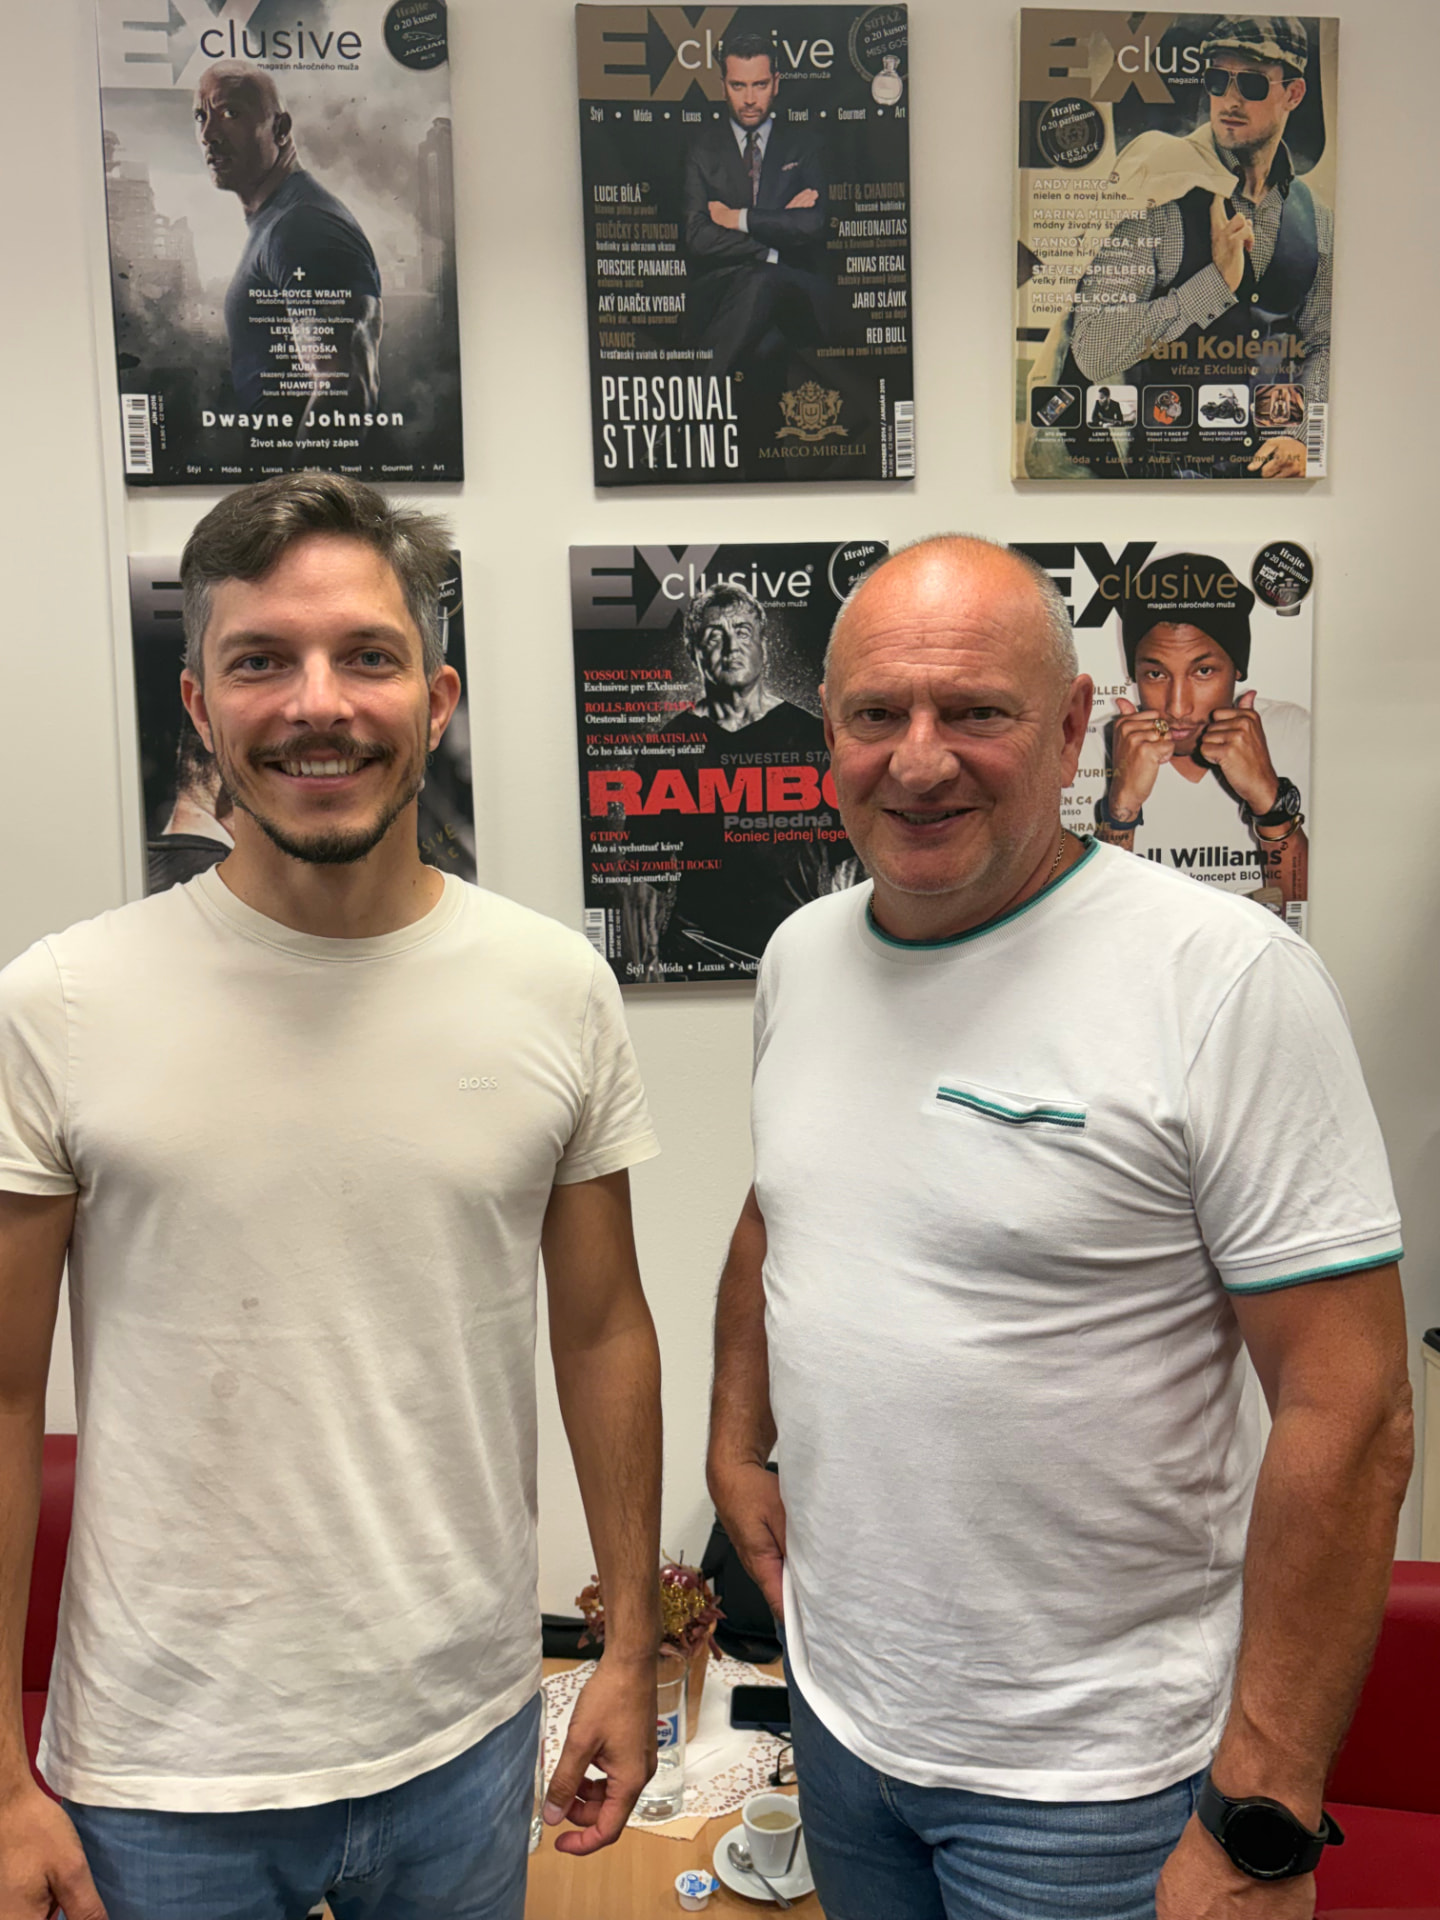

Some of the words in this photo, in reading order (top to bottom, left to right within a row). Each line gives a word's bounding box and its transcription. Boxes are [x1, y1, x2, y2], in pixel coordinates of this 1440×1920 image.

[401, 18, 412, 29] 20
[412, 13, 438, 25] kusov
[872, 30, 882, 41] 20
[882, 24, 907, 37] kusov
[337, 62, 360, 71] muža
[810, 71, 831, 80] muža
[1168, 75, 1199, 84] magazin
[590, 106, 604, 123] Štýl
[633, 108, 653, 122] Móda
[682, 109, 702, 122] Luxus
[788, 108, 809, 121] Travel
[838, 107, 867, 120] Gourmet
[895, 105, 906, 118] Art
[1050, 103, 1081, 118] Hrajte
[1048, 120, 1058, 130] 20
[1058, 110, 1096, 128] parfumov
[1053, 142, 1100, 162] VERSACE
[864, 181, 905, 200] CHANDON
[1033, 179, 1072, 190] ANDY
[1074, 179, 1109, 190] HRYC
[594, 184, 619, 202] LUCIE
[620, 183, 641, 202] BÍLÁ
[1033, 191, 1062, 200] nielen
[1073, 191, 1099, 201] novej
[1033, 209, 1085, 220] MARINA
[1088, 209, 1148, 220] MILITARE
[839, 218, 907, 237] ARQUEONAUTAS
[1033, 220, 1064, 230] módny
[1068, 220, 1102, 230] životný
[1137, 237, 1162, 248] KEF
[1033, 248, 1074, 258] digitálne
[597, 258, 636, 276] PORSCHE
[638, 259, 687, 276] PANAMERA
[846, 256, 877, 273] CHIVAS
[878, 254, 906, 272] REGAL
[1032, 265, 1082, 276] STEVEN
[1086, 264, 1156, 275] SPIELBERG
[1032, 275, 1056, 285] veľký
[249, 289, 313, 298] ROLLS-ROYCE
[315, 289, 352, 298] WRAITH
[852, 291, 876, 309] JARO
[877, 288, 907, 308] SLÁVIK
[1032, 293, 1089, 303] MICHAEL
[598, 293, 615, 312] AKÝ
[617, 293, 651, 312] DARČEK
[652, 293, 686, 312] VYBRAŤ
[287, 308, 317, 317] TAHITI
[1032, 304, 1062, 314] (nie)je
[270, 327, 300, 335] LEXUS
[866, 327, 883, 344] RED
[885, 326, 907, 343] BULL
[599, 331, 636, 348] VIANOCE
[269, 343, 287, 353] JIŘÍ
[289, 343, 338, 353] BARTOŠKA
[291, 363, 317, 371] KUBA
[1171, 364, 1200, 376] víťaz
[280, 381, 317, 389] HUAWEI
[319, 381, 331, 389] P9
[602, 376, 738, 421] PERSONAL
[879, 394, 887, 420] JANUÁR
[202, 411, 294, 430] Dwayne
[305, 410, 404, 427] Johnson
[250, 437, 274, 448] Život
[277, 439, 293, 448] ako
[295, 438, 330, 449] vyhratý
[332, 438, 359, 447] zápas
[603, 424, 739, 469] STYLING
[758, 446, 810, 459] MARCO
[812, 444, 866, 457] MIRELLI
[1186, 455, 1214, 463] Travel
[187, 465, 202, 475] Štýl
[221, 465, 242, 474] Móda
[261, 466, 283, 474] Luxus
[340, 464, 362, 473] Travel
[381, 464, 413, 473] Gourmet
[433, 463, 445, 471] Art
[843, 545, 875, 561] Hrajte
[1279, 547, 1305, 570] Hrajte
[1270, 554, 1280, 564] 20
[1277, 561, 1310, 584] parfumov
[1100, 564, 1239, 601] clusive
[787, 600, 808, 609] muža
[1147, 601, 1177, 610] magazin
[1178, 600, 1215, 610] náročného
[1216, 600, 1236, 609] muža
[583, 670, 629, 681] YOSSOU
[630, 669, 673, 681] N'DOUR
[630, 683, 646, 694] pre
[585, 702, 662, 713] ROLLS-ROYCE
[664, 701, 697, 711] DAWN
[585, 714, 627, 724] Otestovali
[586, 734, 602, 745] HC
[603, 733, 644, 744] SLOVAN
[645, 732, 708, 743] BRATISLAVA
[586, 745, 599, 756] Čo
[600, 745, 612, 755] ho
[613, 745, 632, 755] čaká
[640, 745, 676, 757] domácej
[720, 751, 800, 766] SYLVESTER
[1076, 795, 1092, 806] C4
[724, 811, 833, 830] Posledná
[590, 831, 597, 841] 6
[600, 831, 631, 841] TIPOV
[724, 830, 771, 843] Koniec
[773, 828, 814, 844] jednej
[590, 844, 608, 854] Ako
[609, 844, 617, 853] si
[618, 842, 660, 855] vychutnať
[661, 841, 684, 851] kávu?
[1170, 846, 1282, 868] Williams
[686, 859, 722, 870] ROCKU
[591, 873, 604, 884] Sú
[605, 874, 631, 886] naozaj
[1239, 870, 1281, 881] BIONIC
[626, 963, 645, 977] Štýl
[658, 962, 684, 974] Móda
[697, 961, 726, 972] Luxus
[459, 1076, 498, 1090] BOSS
